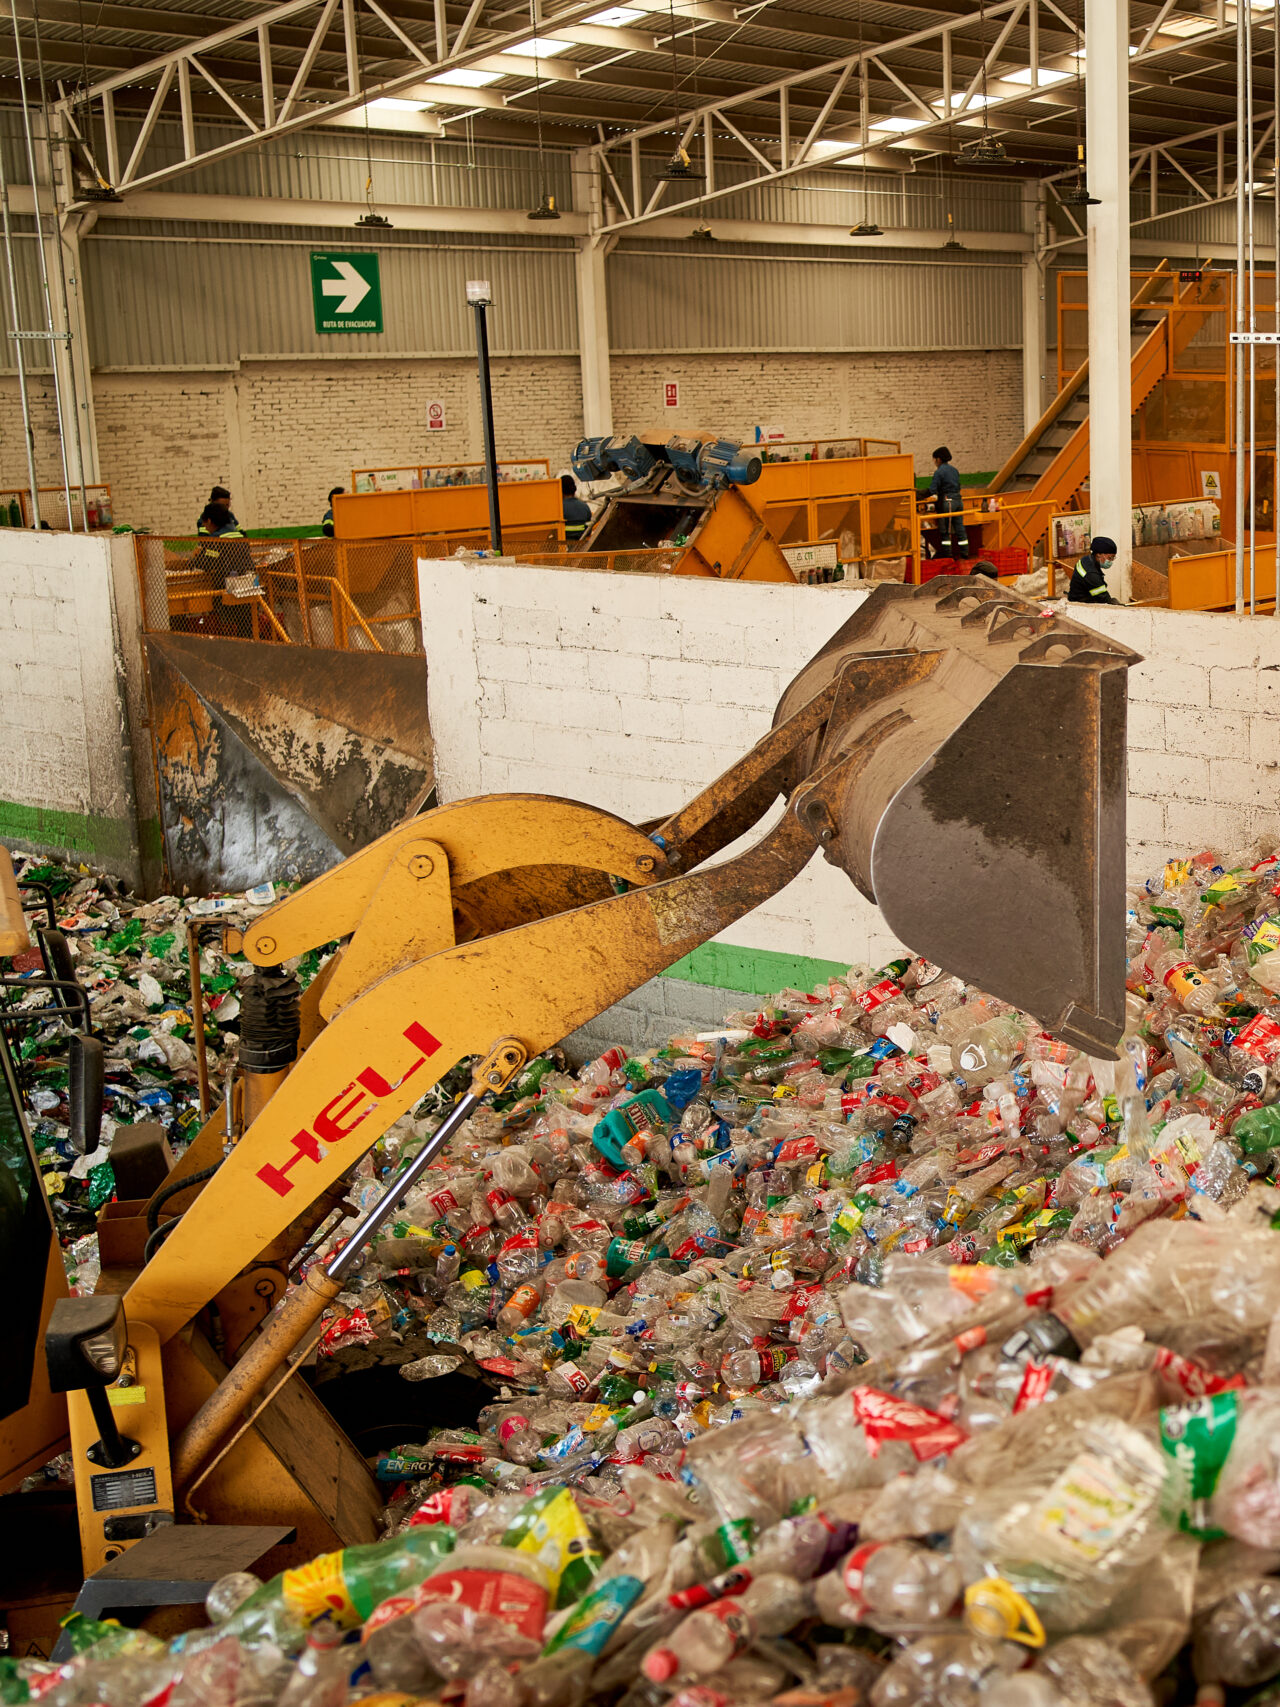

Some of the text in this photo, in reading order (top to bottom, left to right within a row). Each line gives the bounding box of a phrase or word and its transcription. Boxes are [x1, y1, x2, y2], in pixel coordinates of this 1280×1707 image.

[345, 319, 376, 328] EVACUACIÓN
[256, 1021, 443, 1197] HELI
[386, 1460, 434, 1470] ENERGY
